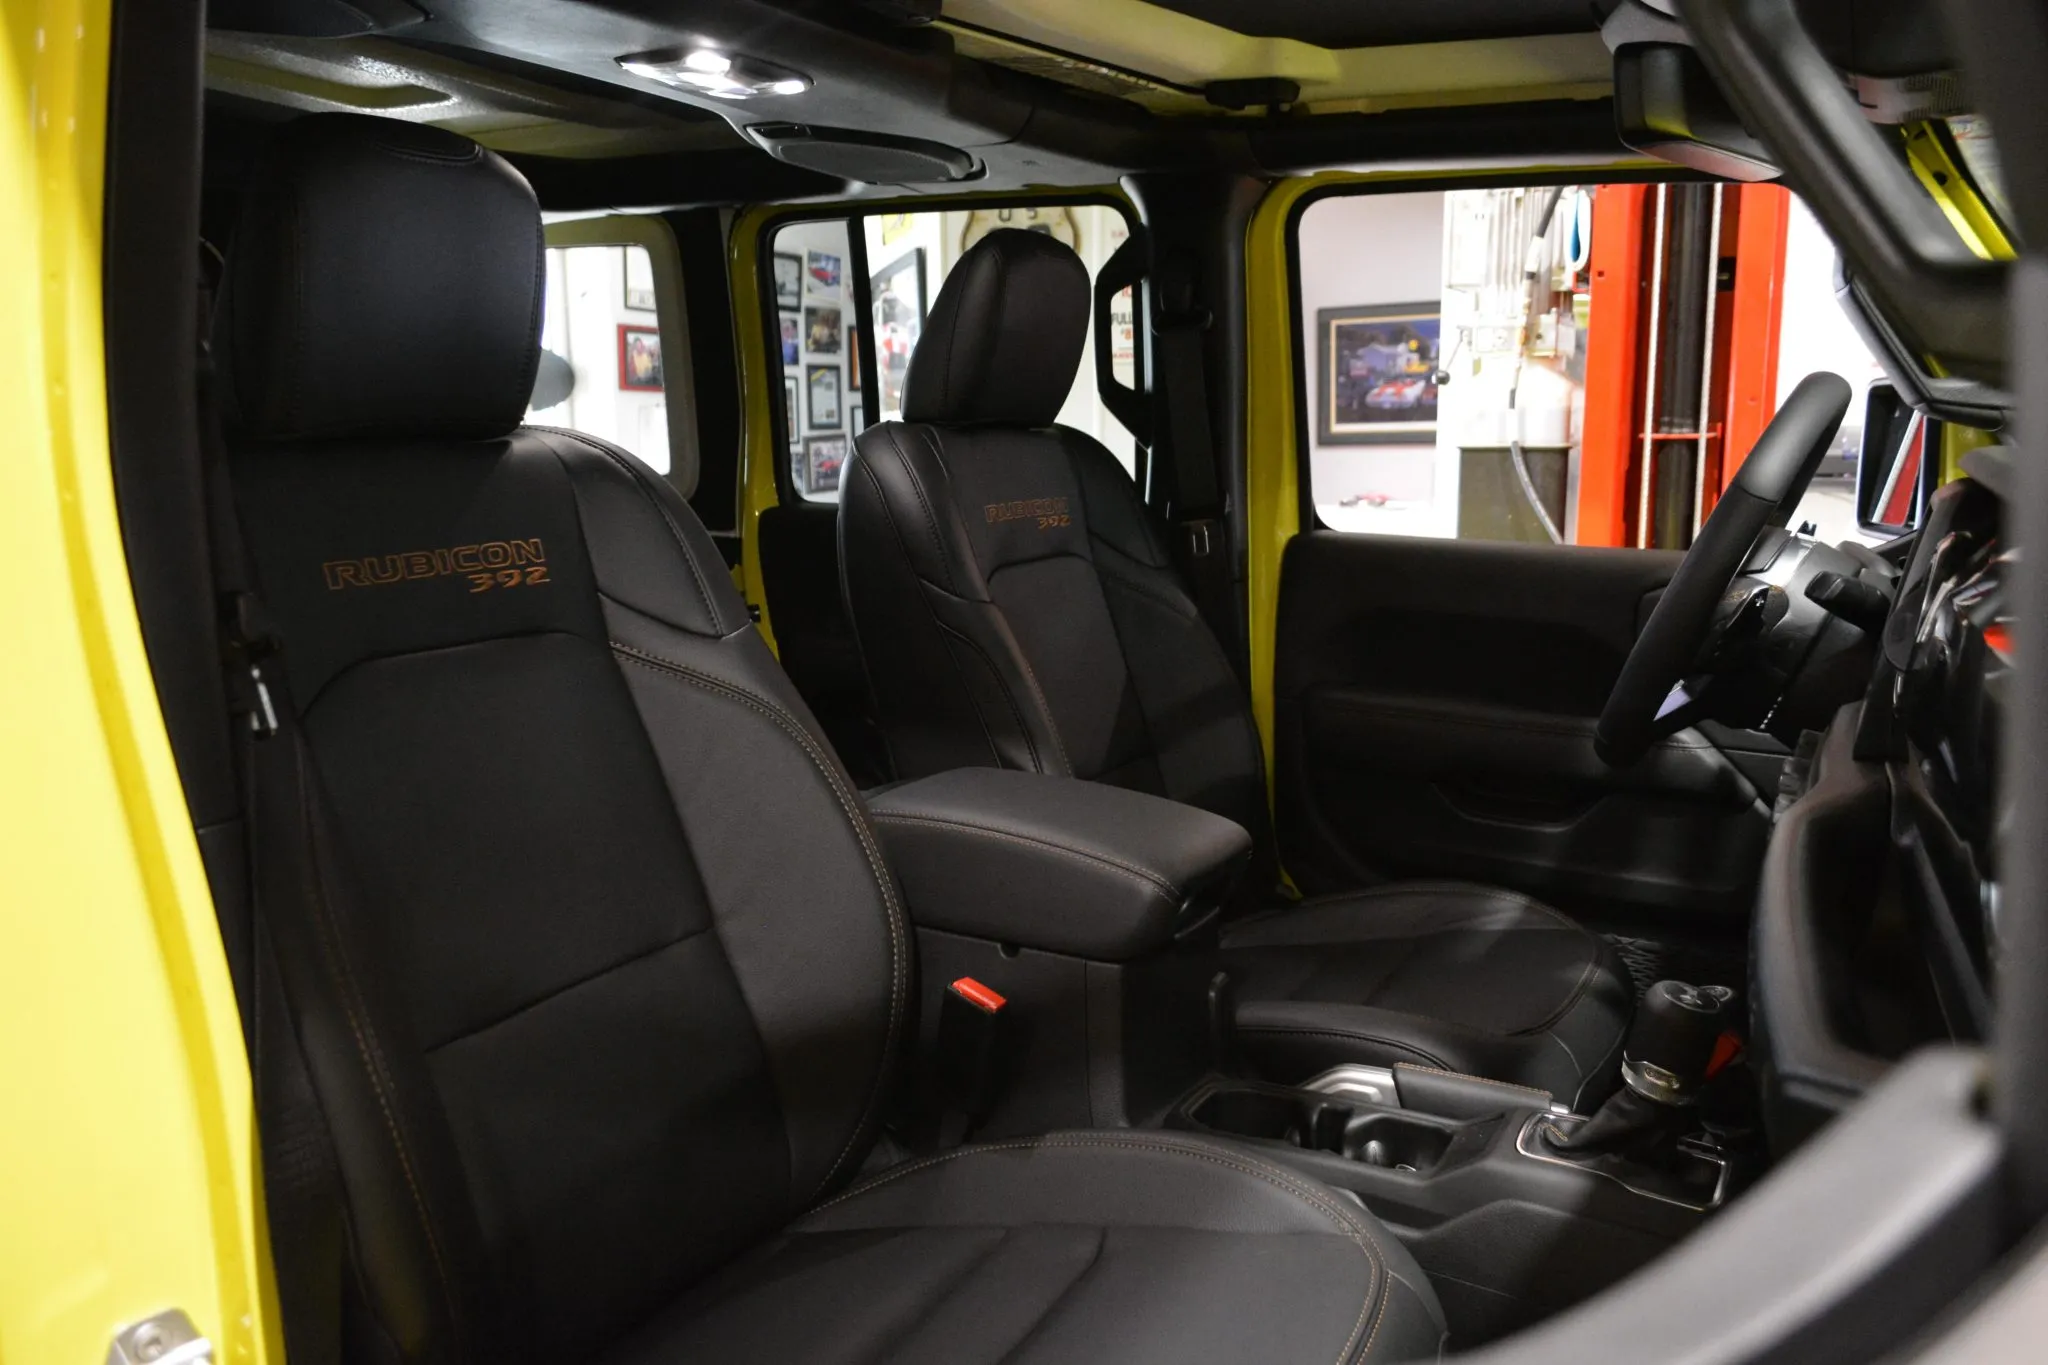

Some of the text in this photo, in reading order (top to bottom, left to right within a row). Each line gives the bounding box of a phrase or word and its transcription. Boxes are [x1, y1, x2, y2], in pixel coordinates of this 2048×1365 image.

[984, 497, 1069, 523] RUBICON
[1037, 515, 1071, 530] 392
[323, 538, 546, 590] RUBICON
[468, 566, 551, 593] 392
